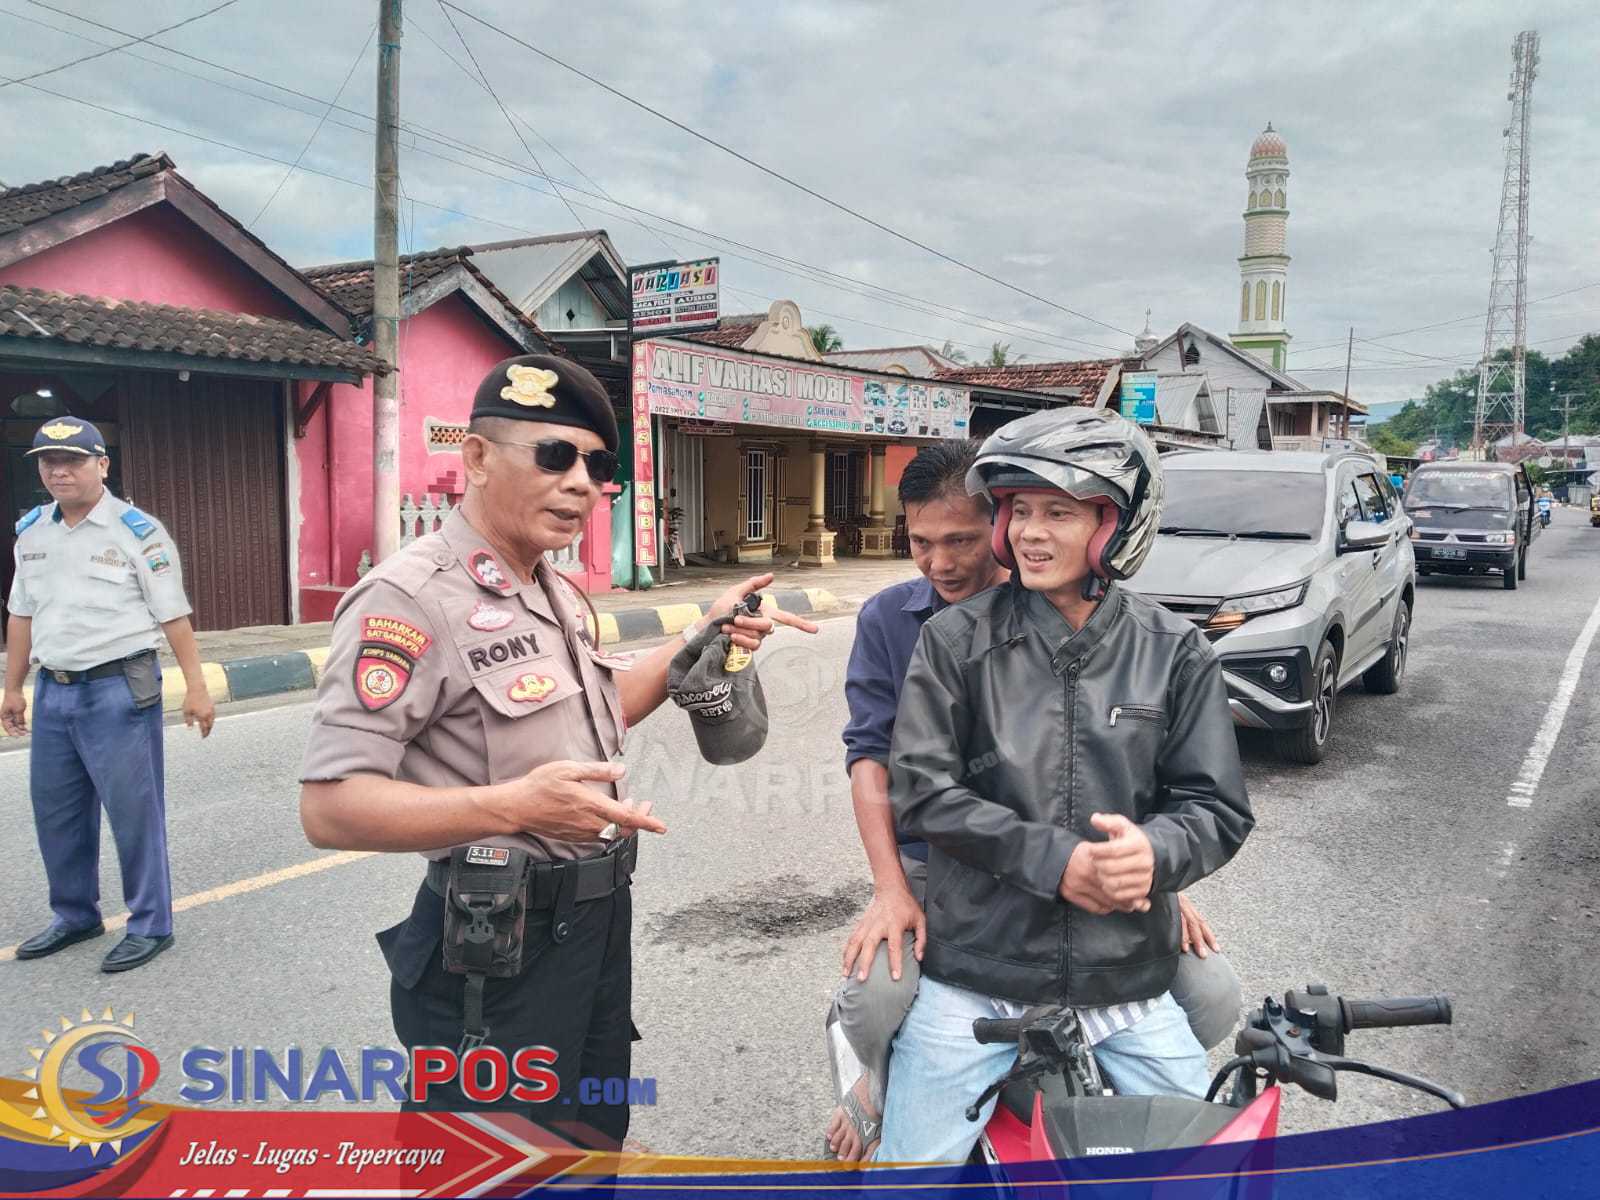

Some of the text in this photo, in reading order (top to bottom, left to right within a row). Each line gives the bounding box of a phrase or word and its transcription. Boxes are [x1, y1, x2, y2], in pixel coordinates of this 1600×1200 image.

[653, 347, 852, 405] ALIF VARIASI MOBIL
[368, 618, 426, 645] BAHARKAM
[467, 633, 540, 671] RONY
[1086, 1147, 1134, 1156] HONDA
